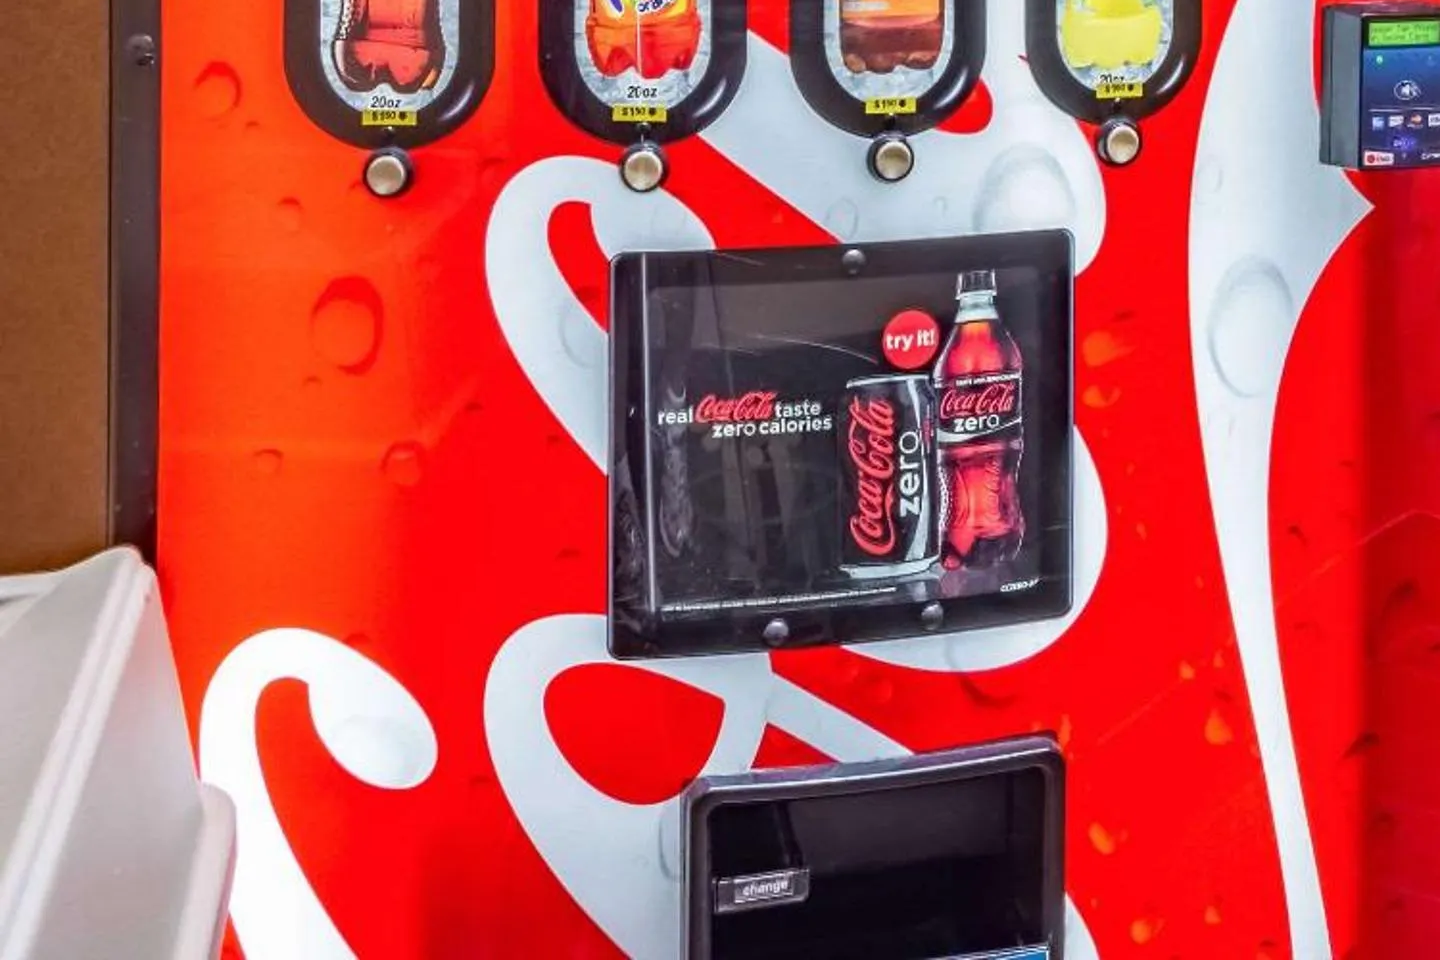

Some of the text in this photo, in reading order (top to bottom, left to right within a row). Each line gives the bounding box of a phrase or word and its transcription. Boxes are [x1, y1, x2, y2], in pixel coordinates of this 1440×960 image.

[370, 95, 402, 109] 20oz
[886, 328, 935, 352] try it!
[658, 405, 693, 425] real
[775, 400, 822, 418] taste
[953, 413, 1000, 433] zero
[712, 416, 833, 439] zero calories
[899, 431, 922, 518] zero
[742, 880, 788, 896] change
